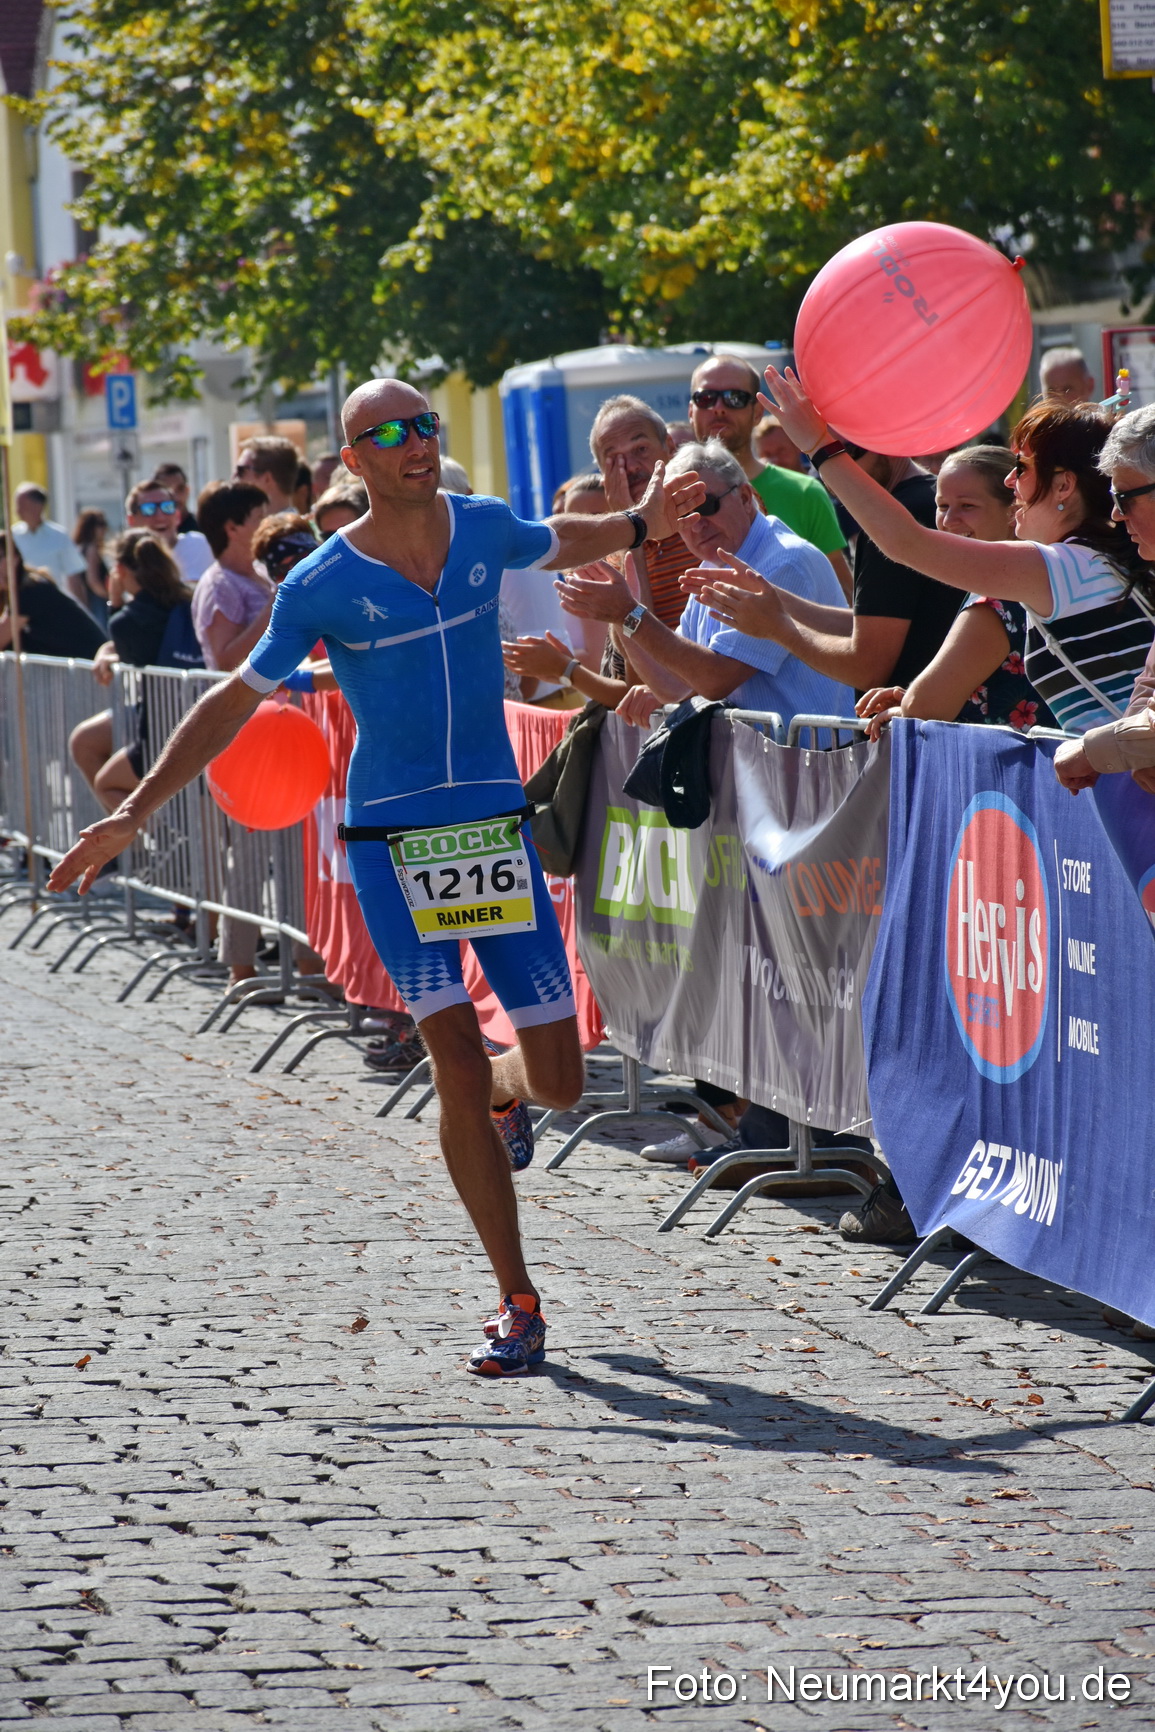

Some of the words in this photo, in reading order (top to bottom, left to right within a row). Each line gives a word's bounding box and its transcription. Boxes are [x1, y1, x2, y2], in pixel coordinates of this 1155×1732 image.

[402, 822, 513, 862] BOCK
[413, 859, 515, 900] 1216
[1062, 858, 1092, 894] STORE
[437, 906, 504, 926] RAINER
[957, 859, 1043, 1017] Hervis
[1067, 937, 1097, 975] ONLINE
[1068, 1015, 1100, 1055] MOBILE
[950, 1139, 1012, 1201] GET
